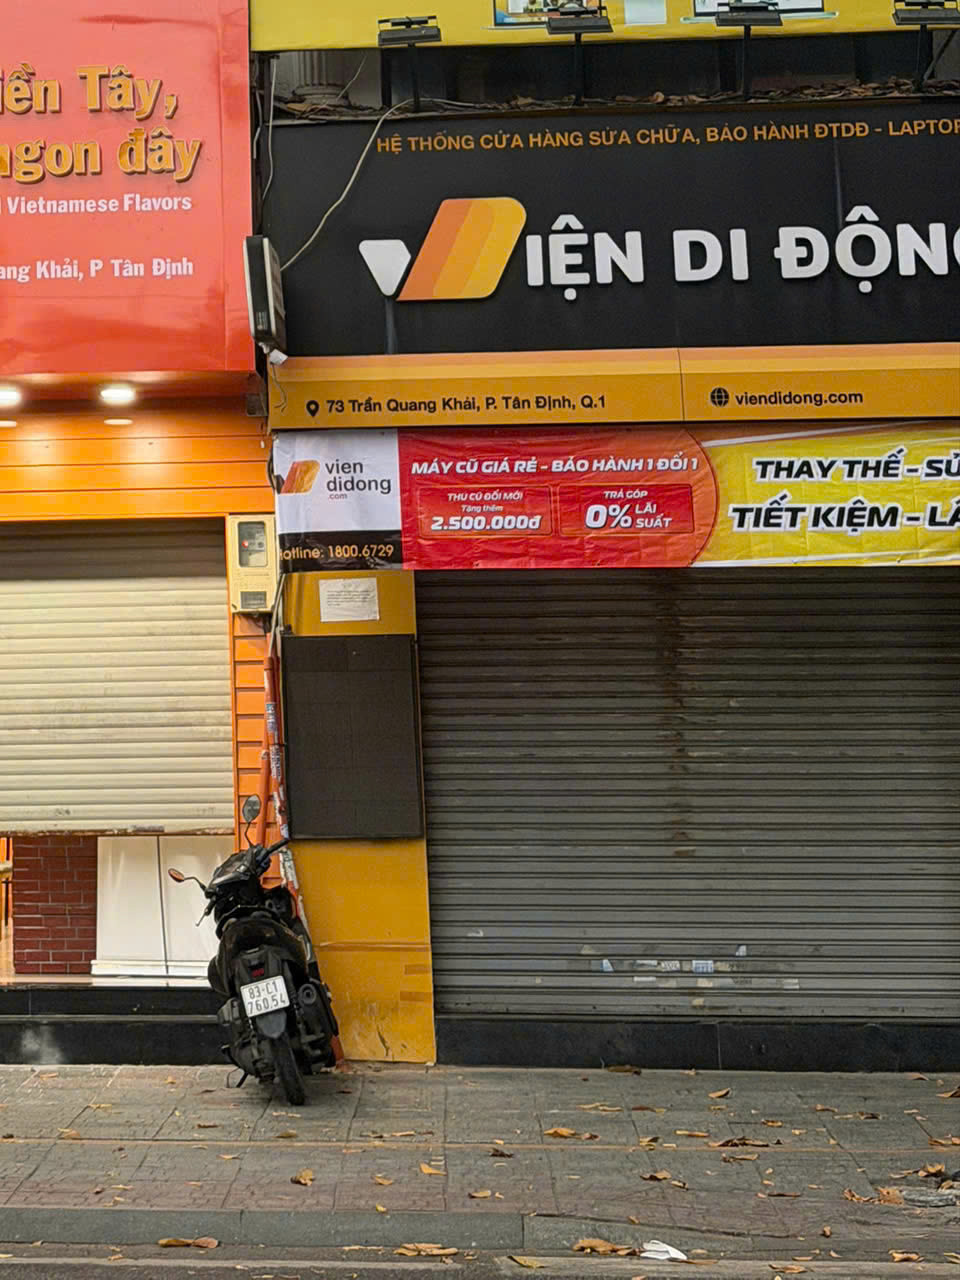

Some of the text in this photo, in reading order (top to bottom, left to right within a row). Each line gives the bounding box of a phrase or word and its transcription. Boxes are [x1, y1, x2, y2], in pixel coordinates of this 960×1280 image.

[77, 64, 179, 119] Tây,
[376, 133, 402, 155] HỆ
[407, 129, 475, 151] THỐNG
[479, 130, 524, 150] CỬA
[529, 128, 583, 148] HÀNG
[589, 126, 632, 146] SỬA
[706, 123, 748, 142] BẢO
[753, 120, 808, 140] HÀNH
[814, 122, 870, 139] ĐTDĐ
[117, 126, 202, 182] đây
[7, 196, 119, 215] Vietnamese
[123, 193, 192, 212] Flavors
[672, 227, 749, 282] DI
[773, 205, 960, 294] ĐỘN
[36, 258, 84, 281] Khải,
[90, 261, 103, 277] P
[110, 258, 144, 277] Tân
[152, 257, 193, 280] Định
[327, 400, 344, 413] 73
[348, 396, 382, 413] Trần
[386, 398, 437, 414] Quang
[442, 395, 480, 412] Khải,
[485, 397, 497, 410] P.
[502, 395, 531, 410] Tân
[580, 395, 606, 410] Q.1
[735, 390, 863, 407] viendidong.com
[325, 459, 363, 474] vien
[411, 451, 698, 475] MÁY CŨ GIÁ RẺ BẢO HÀNH 1 ĐỔI 1
[755, 459, 837, 479] THAY
[843, 448, 905, 478] THẾ
[326, 476, 391, 494] didong
[627, 489, 648, 499] GÓP
[447, 493, 468, 501] THU
[482, 504, 503, 512] thêm
[585, 503, 631, 529] 0%
[635, 502, 657, 514] LÃI
[732, 494, 807, 528] TIẾT
[811, 499, 899, 532] KIỆM
[431, 515, 541, 532] 2.500.000đ
[636, 515, 672, 528] SUẤT
[328, 545, 394, 559] 1800.6729
